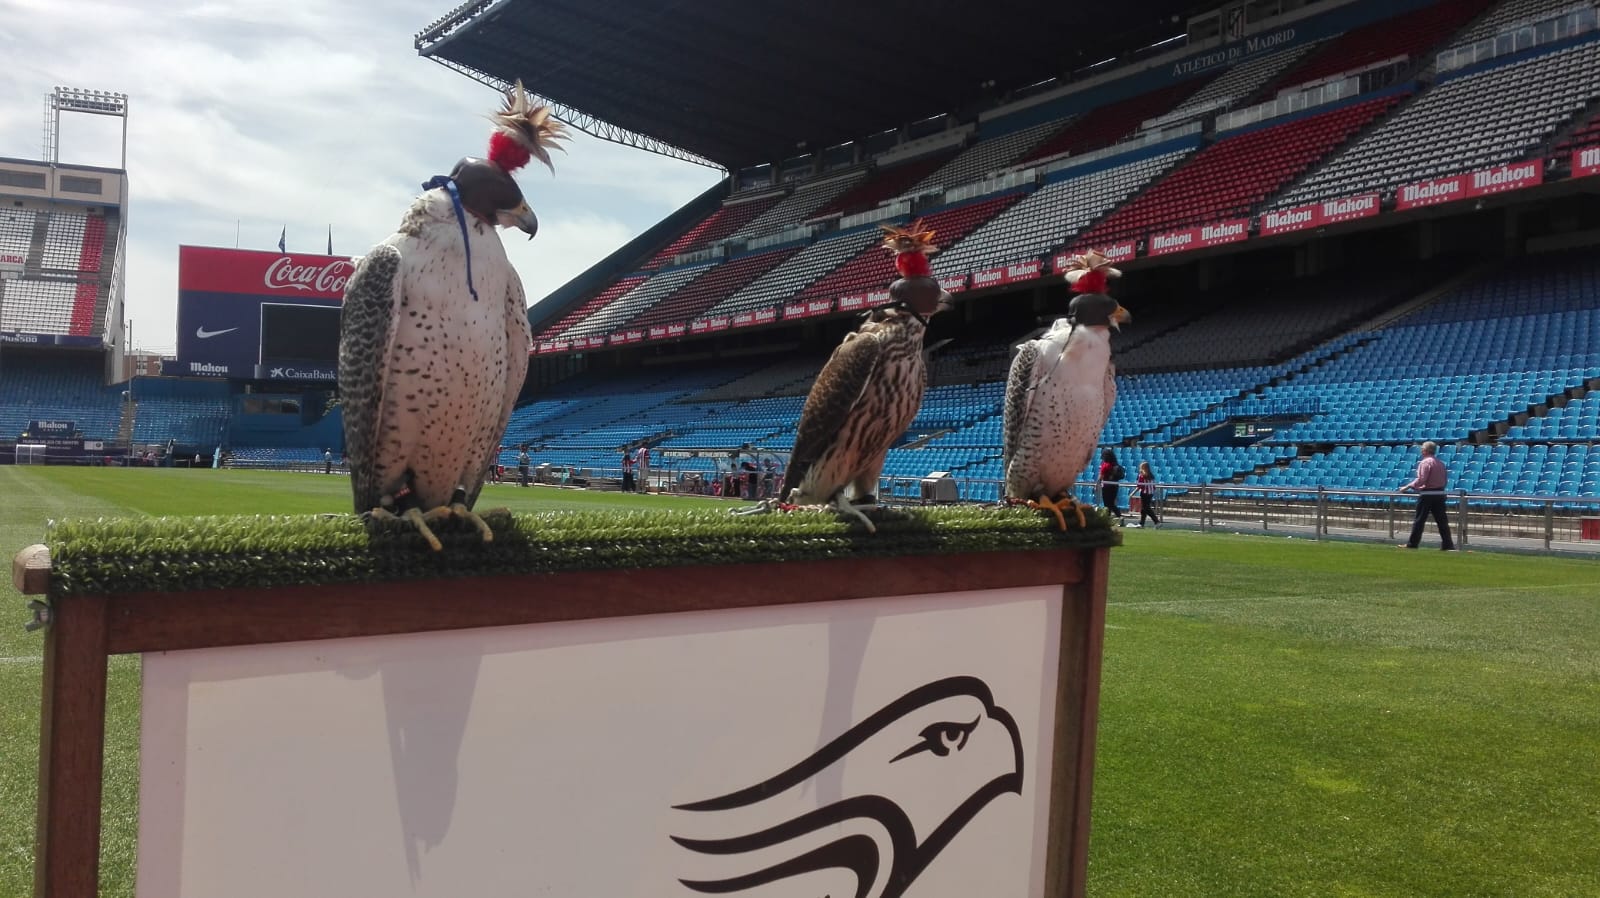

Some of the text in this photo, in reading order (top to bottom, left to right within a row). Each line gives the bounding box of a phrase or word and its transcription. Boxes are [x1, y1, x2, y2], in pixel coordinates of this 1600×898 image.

[1228, 47, 1241, 59] DE
[1247, 29, 1295, 53] MADRID
[1474, 165, 1535, 188] Mahou
[1404, 179, 1459, 201] Mahou
[1324, 197, 1374, 217] Mahou
[1266, 209, 1313, 229] Mahou
[1201, 223, 1243, 241] Mahou
[1153, 232, 1192, 249] Mahou
[0, 254, 25, 264] ARCA
[1104, 244, 1132, 258] ahou
[264, 256, 357, 293] Coca-Co
[974, 270, 1002, 284] Mahou
[1008, 263, 1038, 278] Mahou
[938, 277, 963, 290] Mahou
[190, 362, 228, 373] Mahou
[285, 368, 336, 380] CaixaBank
[38, 421, 68, 430] Mahou
